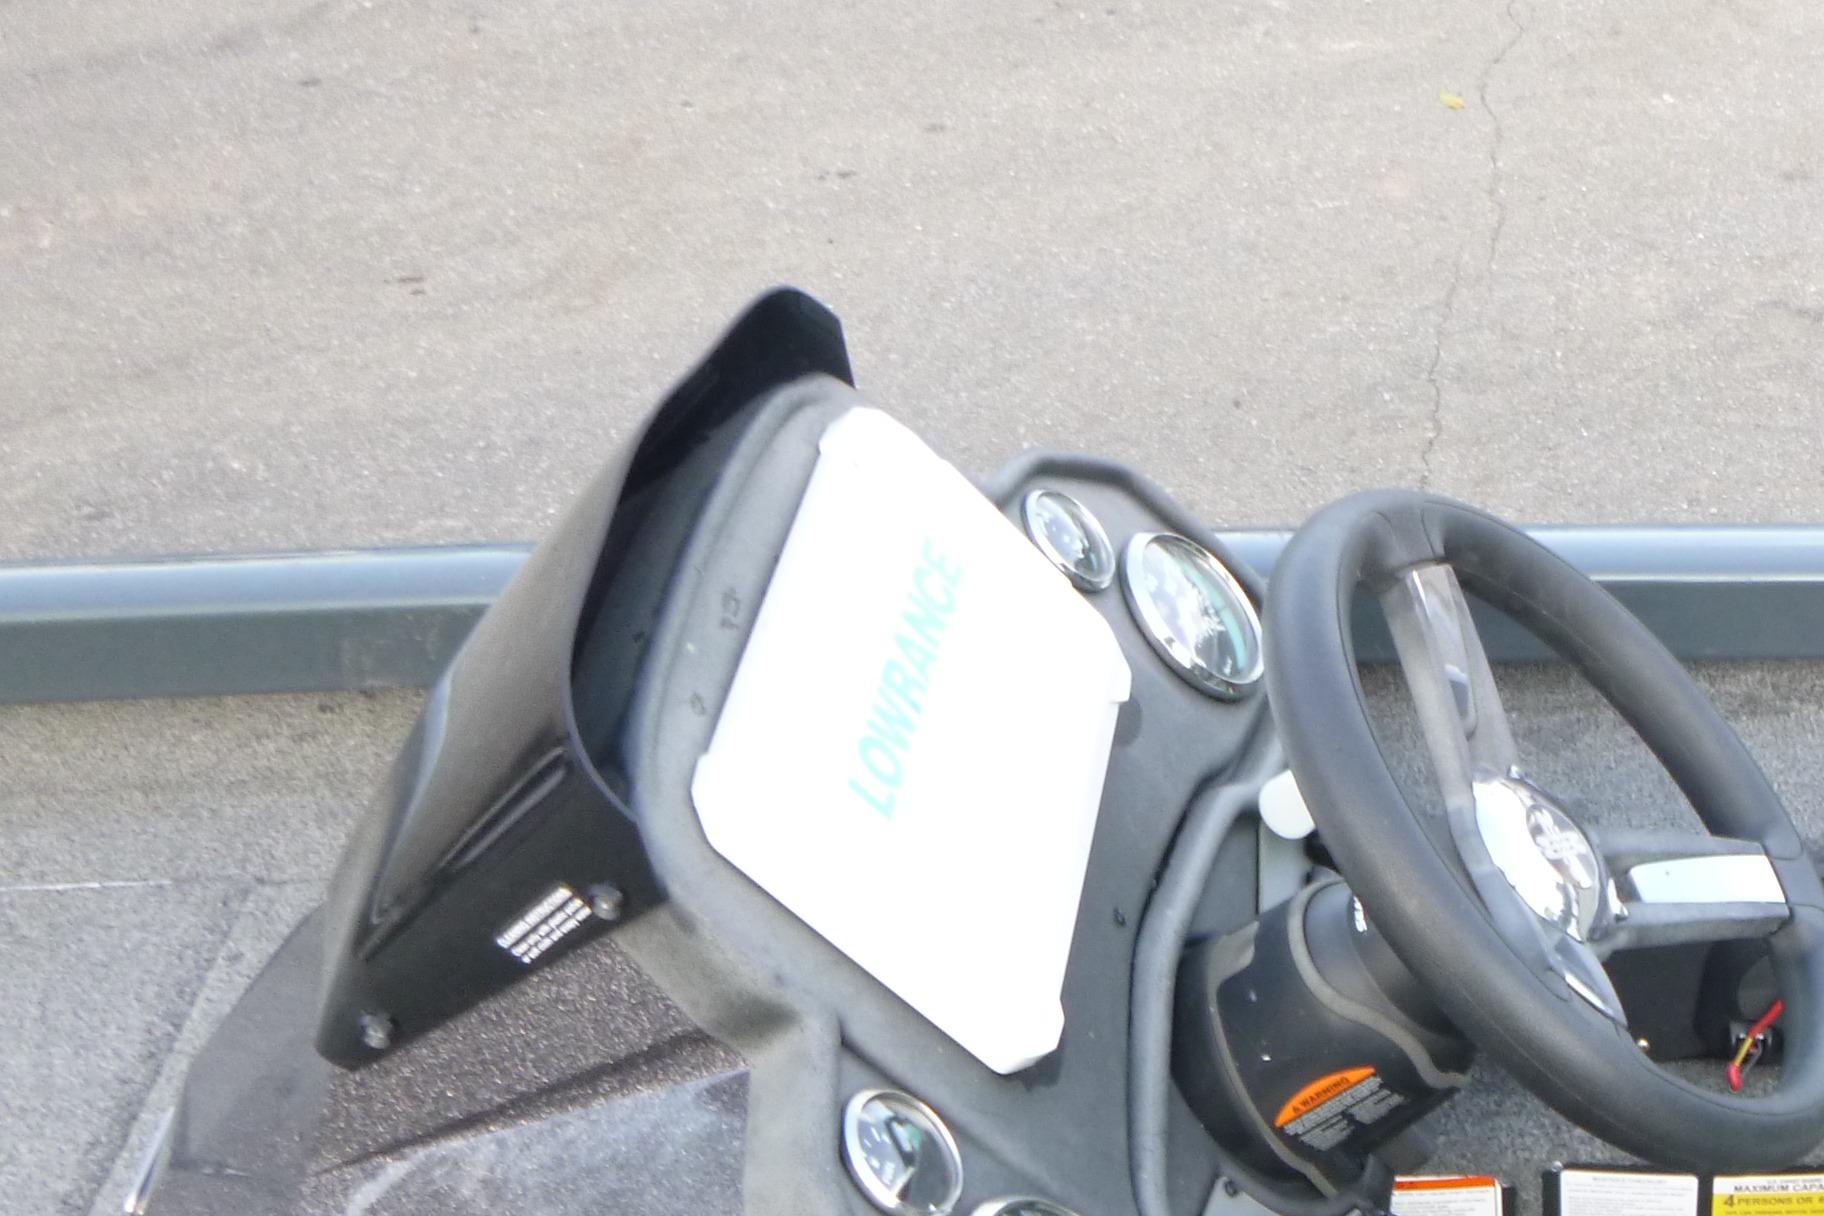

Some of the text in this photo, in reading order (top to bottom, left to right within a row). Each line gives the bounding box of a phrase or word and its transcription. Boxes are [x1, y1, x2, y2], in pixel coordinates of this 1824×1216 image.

[847, 536, 964, 821] LOWRANCE
[1300, 1077, 1350, 1107] WARNING
[1733, 1184, 1789, 1192] MAXIMUM
[1724, 1194, 1735, 1208] 4
[1737, 1197, 1793, 1206] PERSONS
[1796, 1196, 1813, 1205] OR
